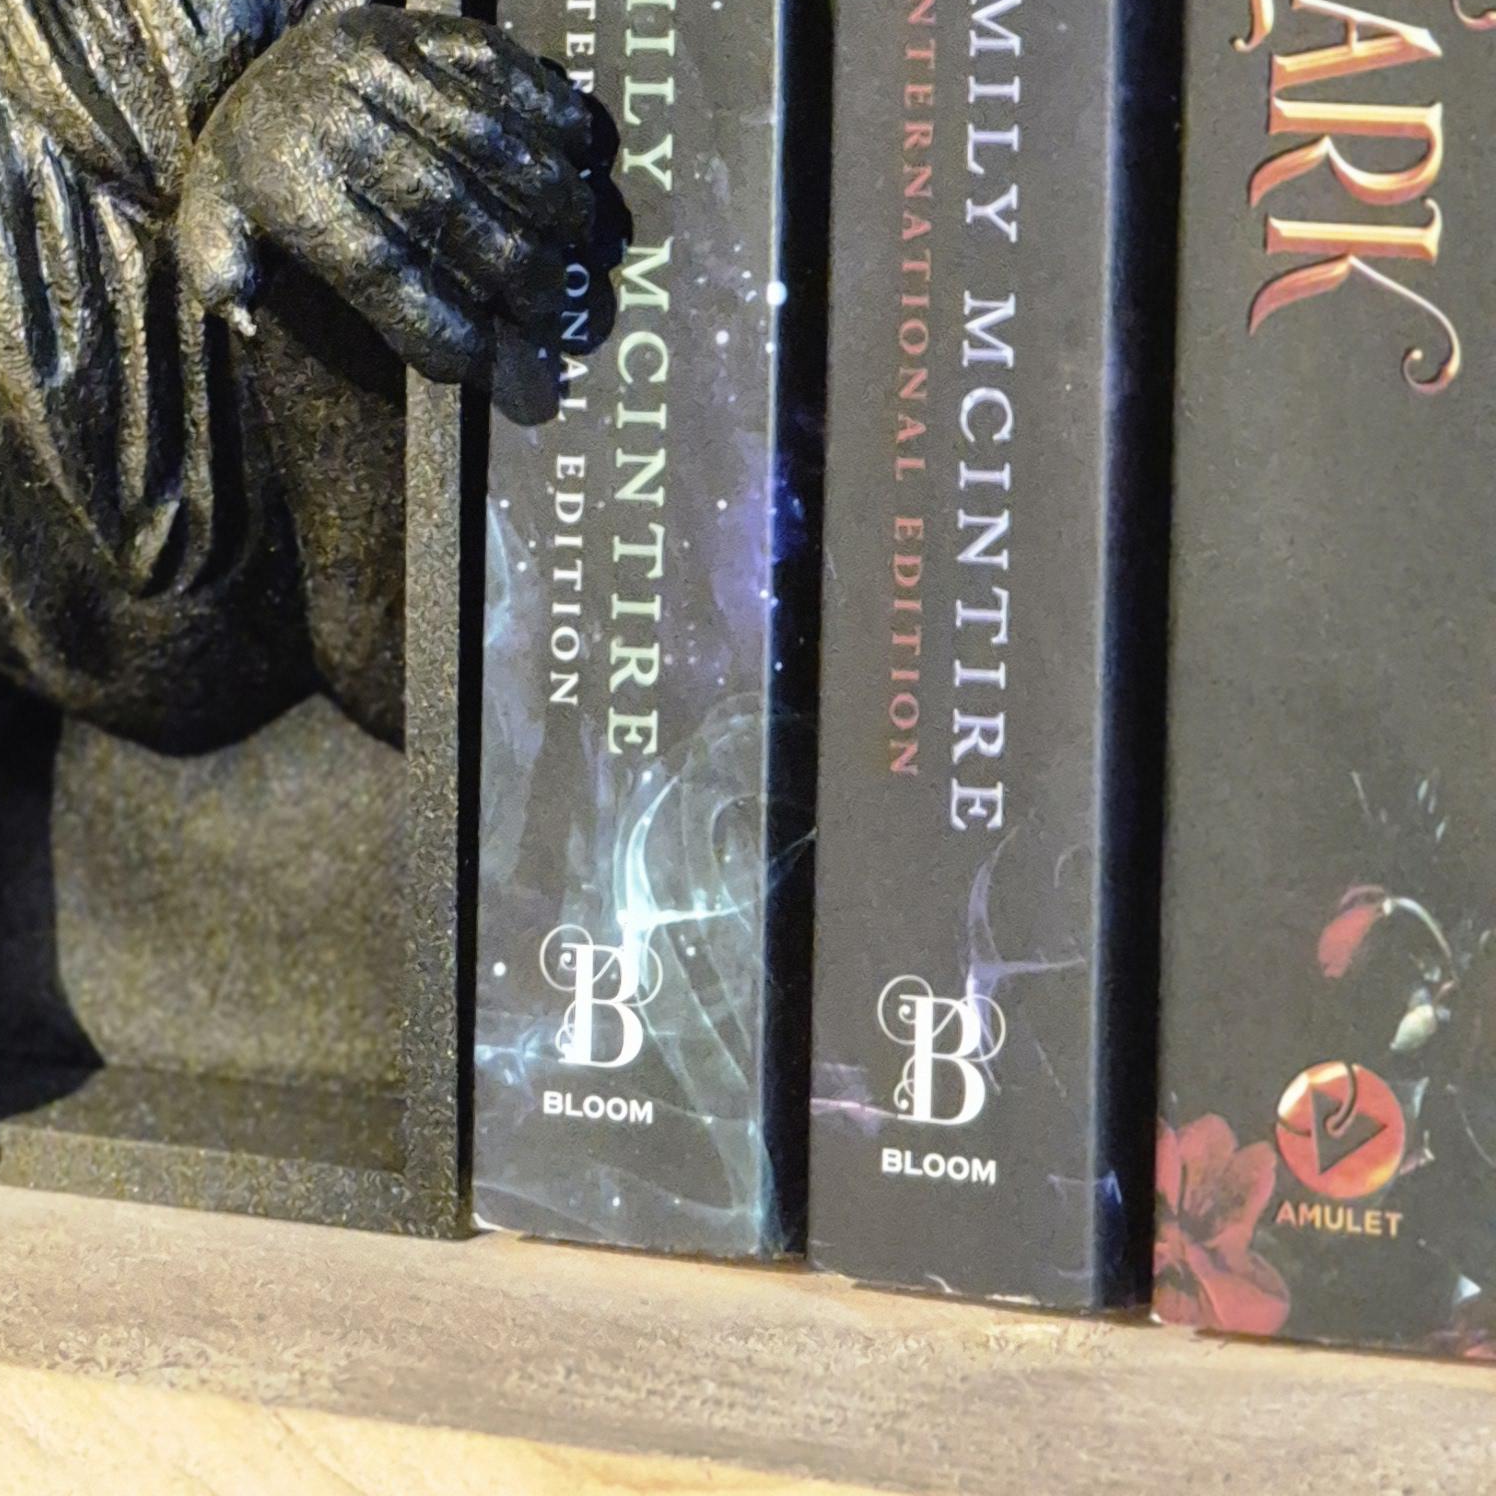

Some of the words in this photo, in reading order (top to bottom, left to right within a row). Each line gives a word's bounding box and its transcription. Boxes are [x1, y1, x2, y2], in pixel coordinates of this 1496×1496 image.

[606, 236, 674, 756] MCINTIRE
[950, 290, 1016, 832] MCINTIRE
[548, 455, 587, 706] EDITION
[888, 516, 925, 776] EDITION
[540, 924, 663, 1067] B
[877, 974, 1006, 1126] B
[542, 1090, 654, 1124] BLOOM
[881, 1148, 997, 1185] BLOOM
[1275, 1199, 1403, 1237] AMULET
